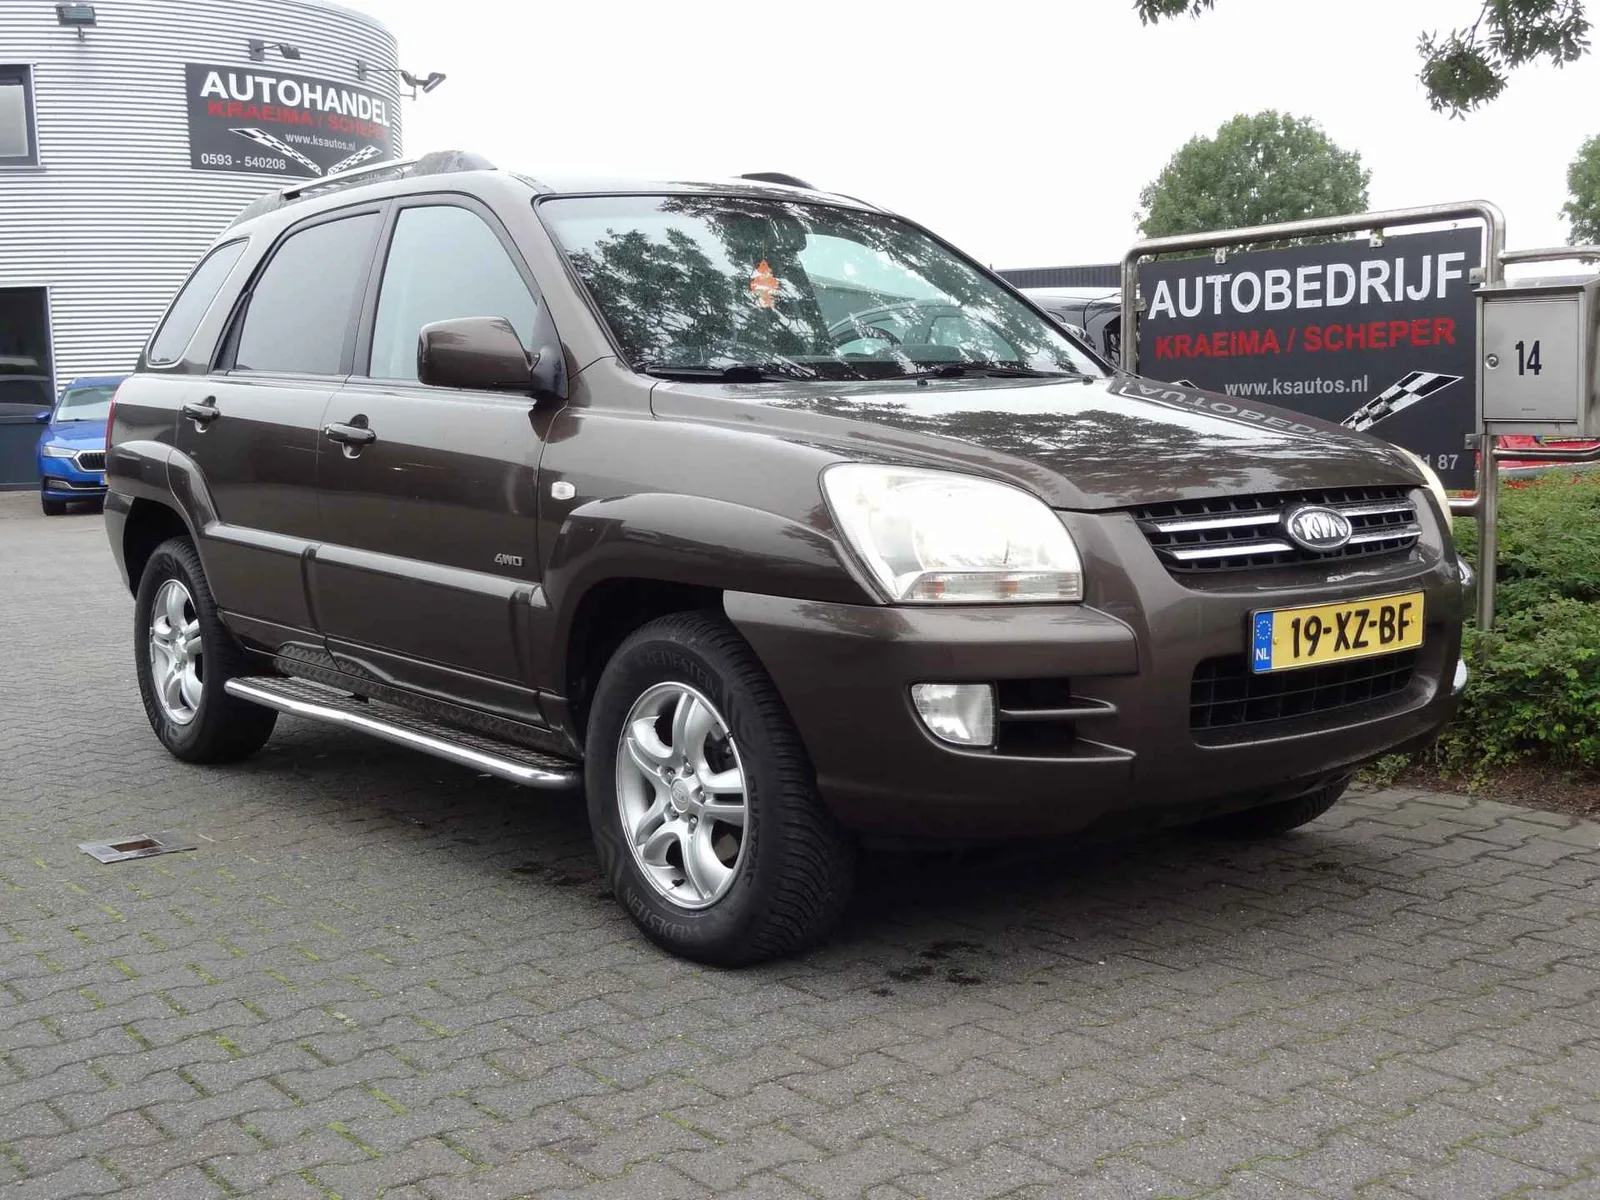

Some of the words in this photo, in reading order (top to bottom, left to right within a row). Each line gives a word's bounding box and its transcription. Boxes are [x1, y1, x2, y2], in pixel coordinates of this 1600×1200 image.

[200, 71, 390, 127] AUTOHANDEL
[208, 99, 313, 125] KRAEIMA
[285, 133, 356, 151] www.ksautos.nl
[201, 153, 232, 166] 0593
[245, 156, 286, 170] 540208
[1148, 252, 1465, 320] AUTOBEDRIJF
[1155, 329, 1280, 360] KRAEIMA
[1304, 317, 1456, 351] SCHEPER
[1515, 340, 1542, 376] 14
[1225, 375, 1369, 397] www.ksautos.nl
[1438, 453, 1459, 470] 87
[494, 553, 523, 567] 4WD
[1291, 601, 1412, 658] 19-XZ-BF
[1255, 648, 1270, 661] NL
